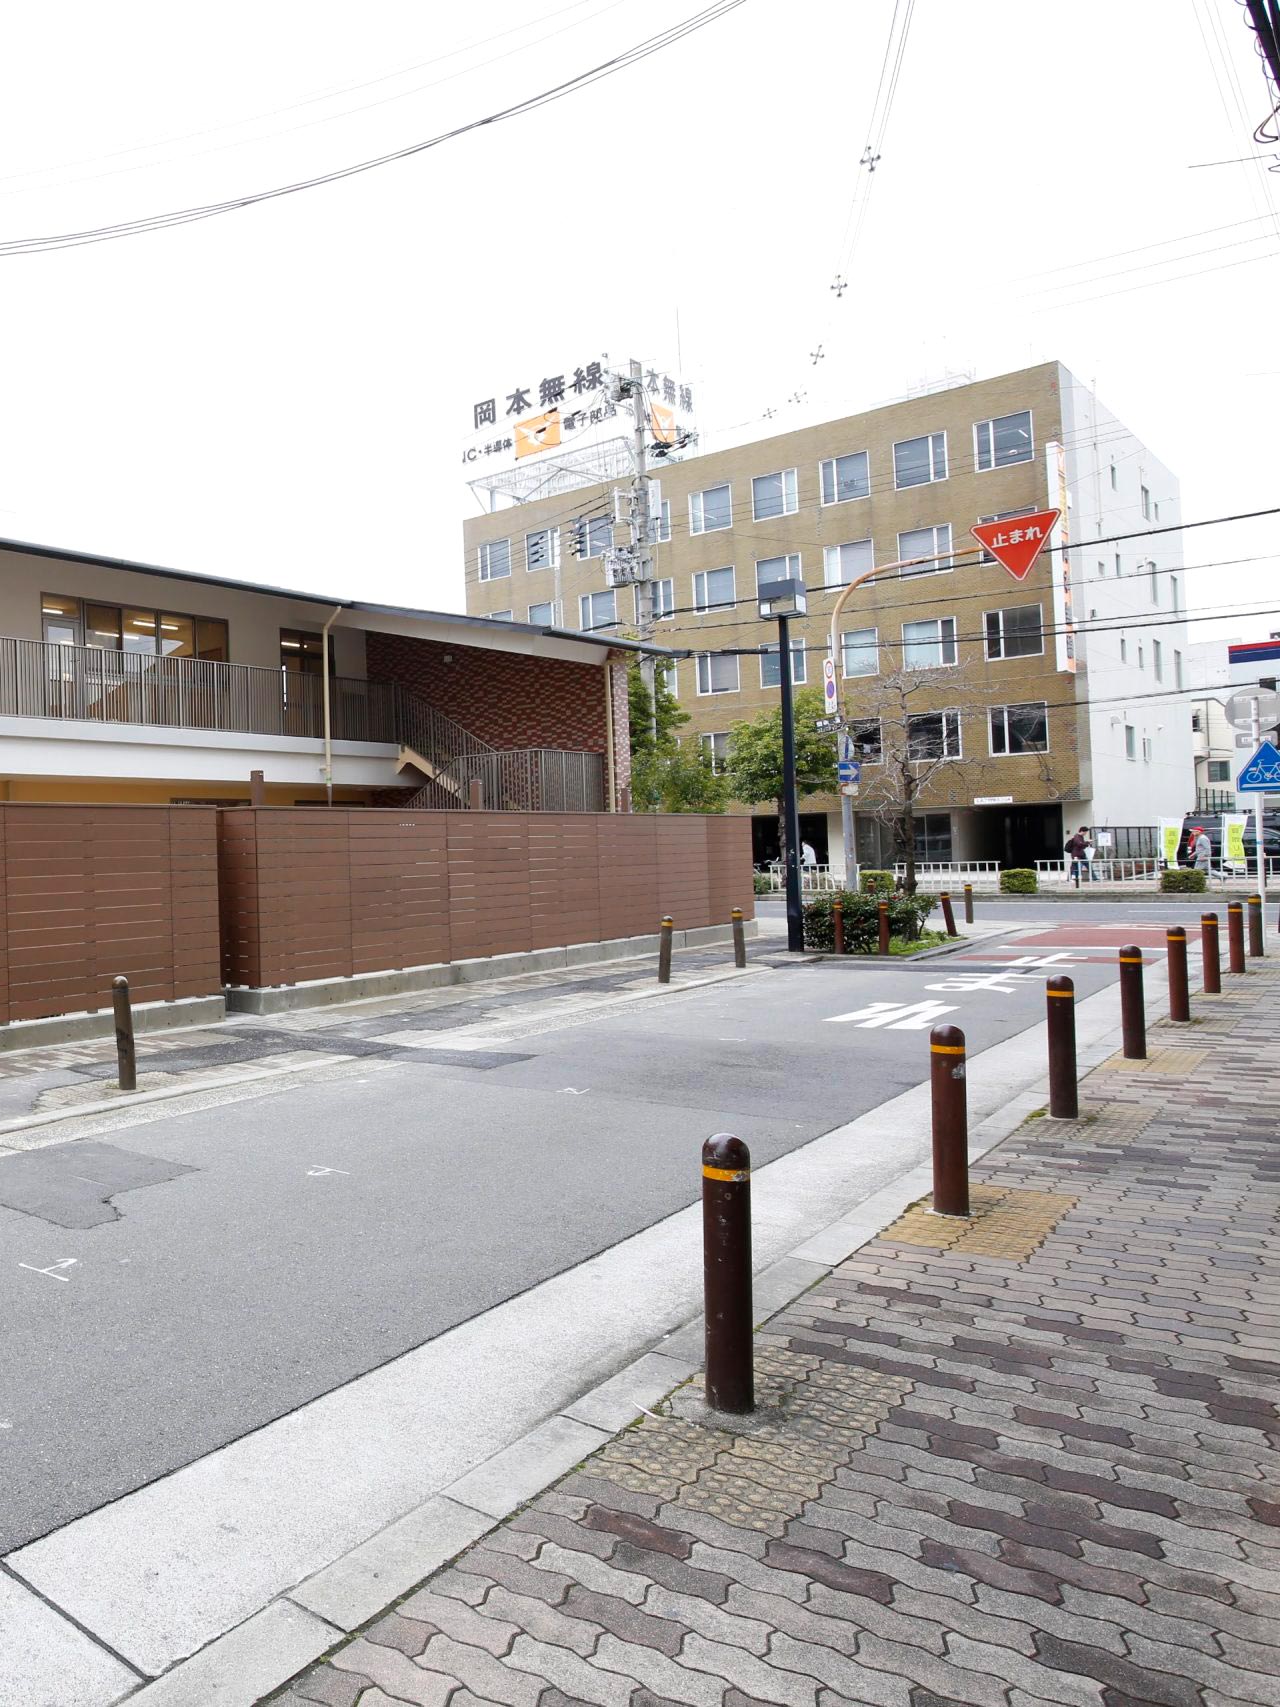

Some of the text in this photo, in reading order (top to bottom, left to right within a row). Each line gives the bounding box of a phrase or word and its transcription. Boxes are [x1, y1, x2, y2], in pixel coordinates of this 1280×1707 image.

[473, 361, 604, 430] 岡本無線
[990, 526, 1044, 549] 止まれ
[821, 952, 1088, 1030] 止まれ
